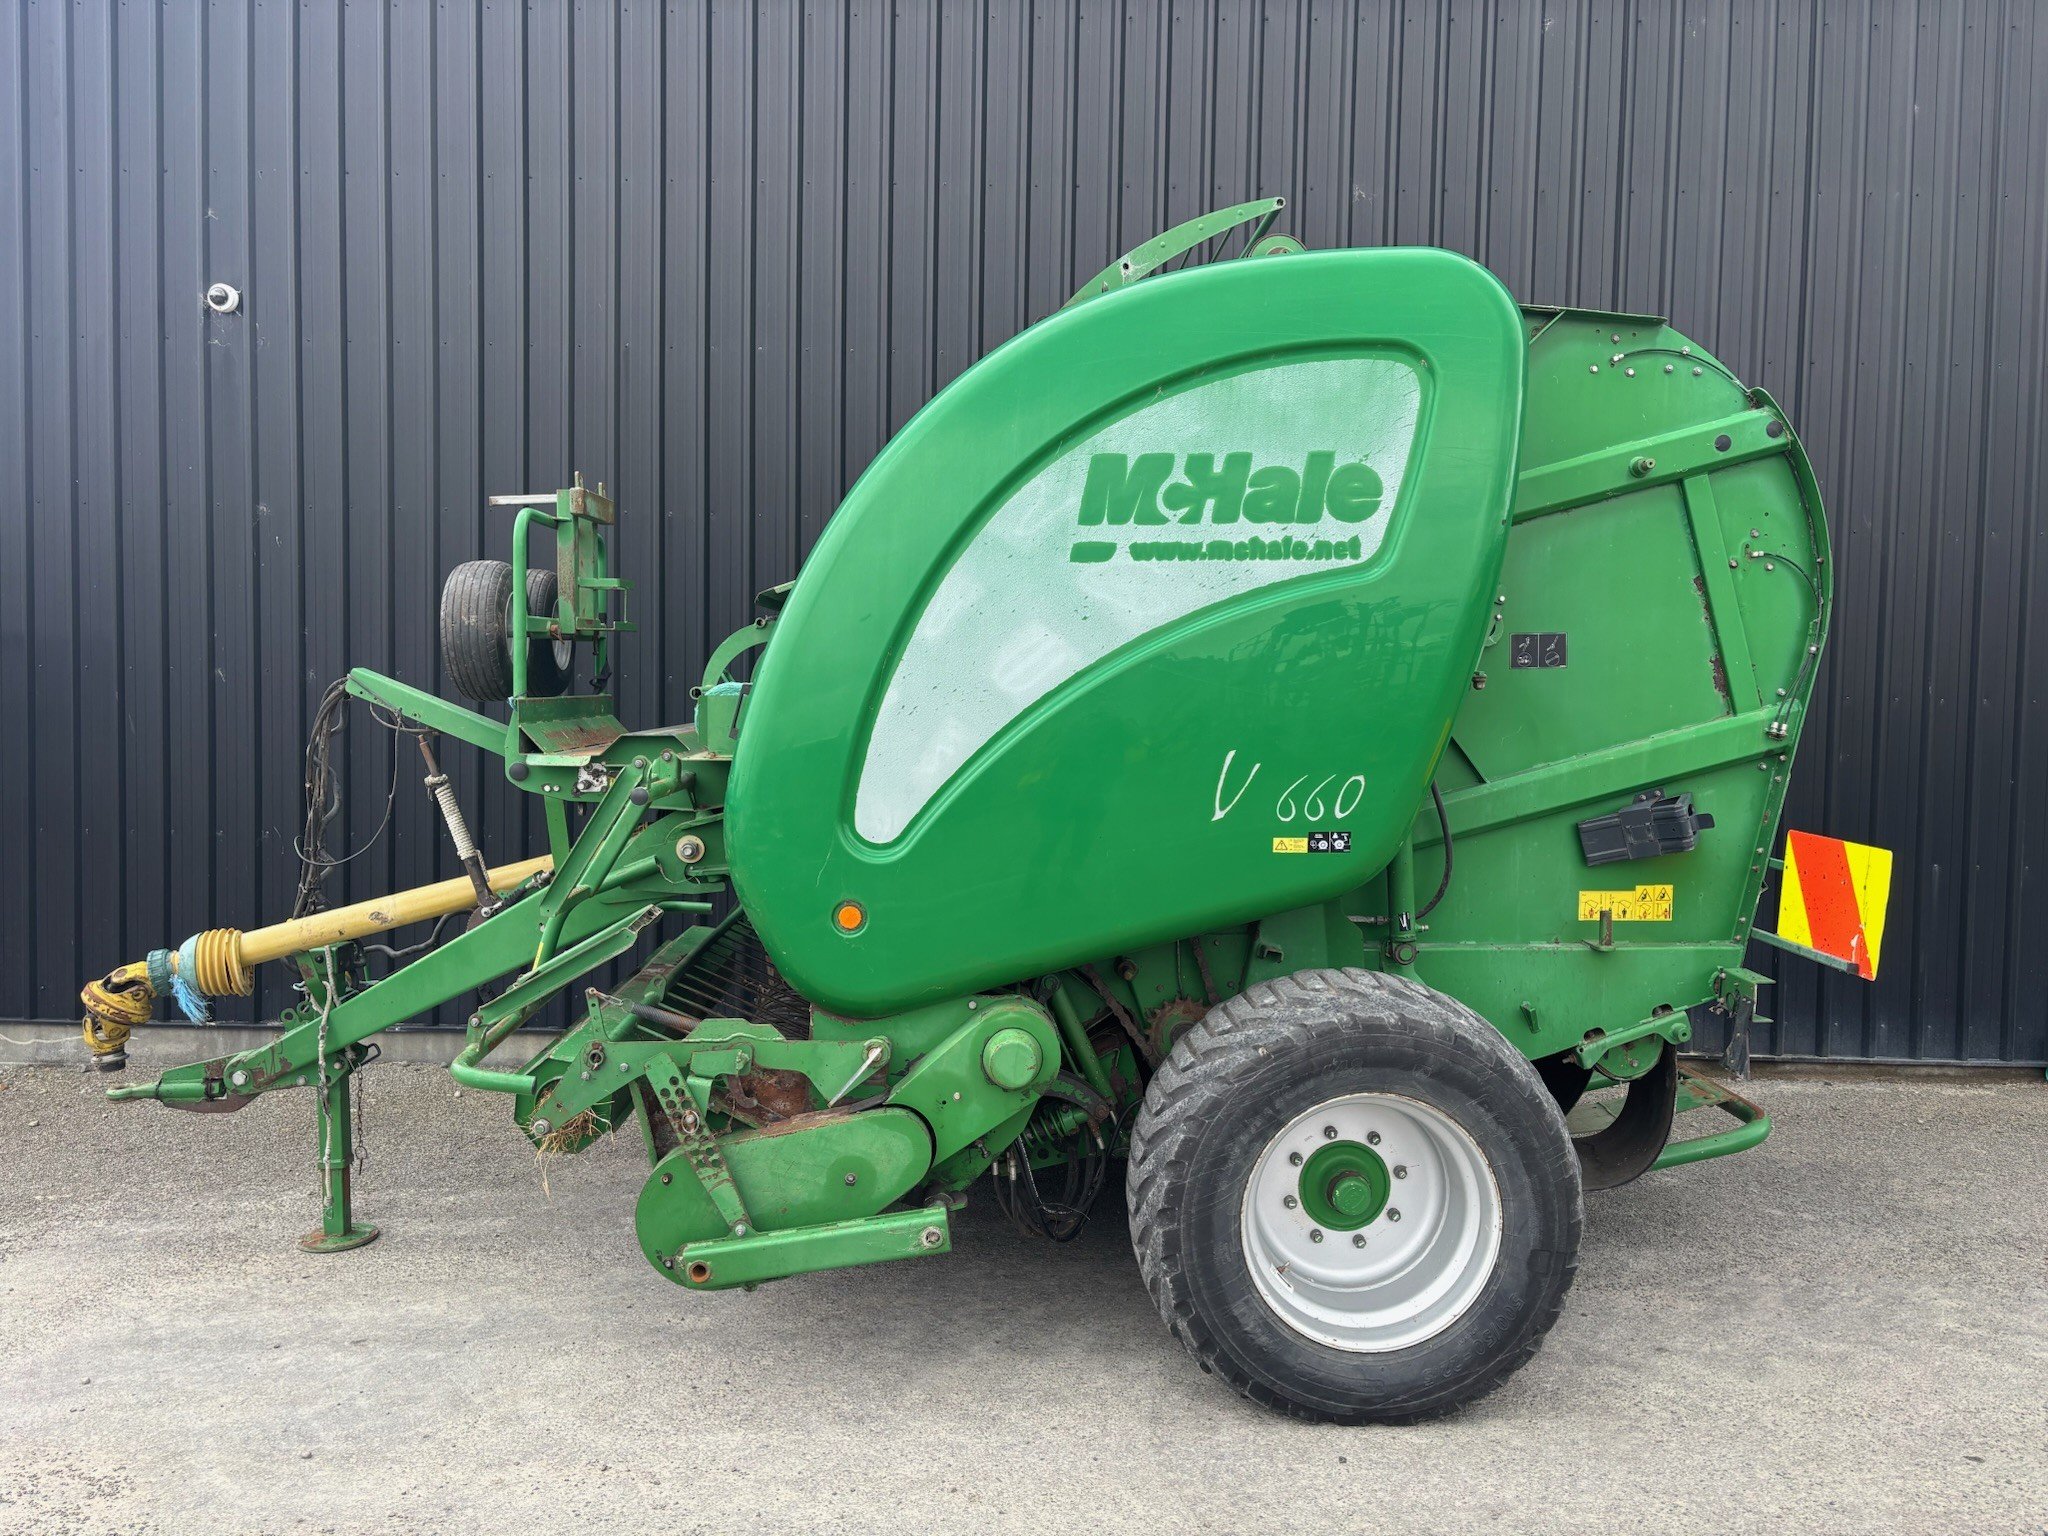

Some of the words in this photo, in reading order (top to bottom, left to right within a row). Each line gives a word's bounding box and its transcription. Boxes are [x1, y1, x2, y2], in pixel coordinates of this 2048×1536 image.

[1077, 450, 1384, 526] McHale
[1128, 534, 1362, 562] www.mchale.net
[1211, 749, 1261, 821] V
[1276, 774, 1365, 821] 660
